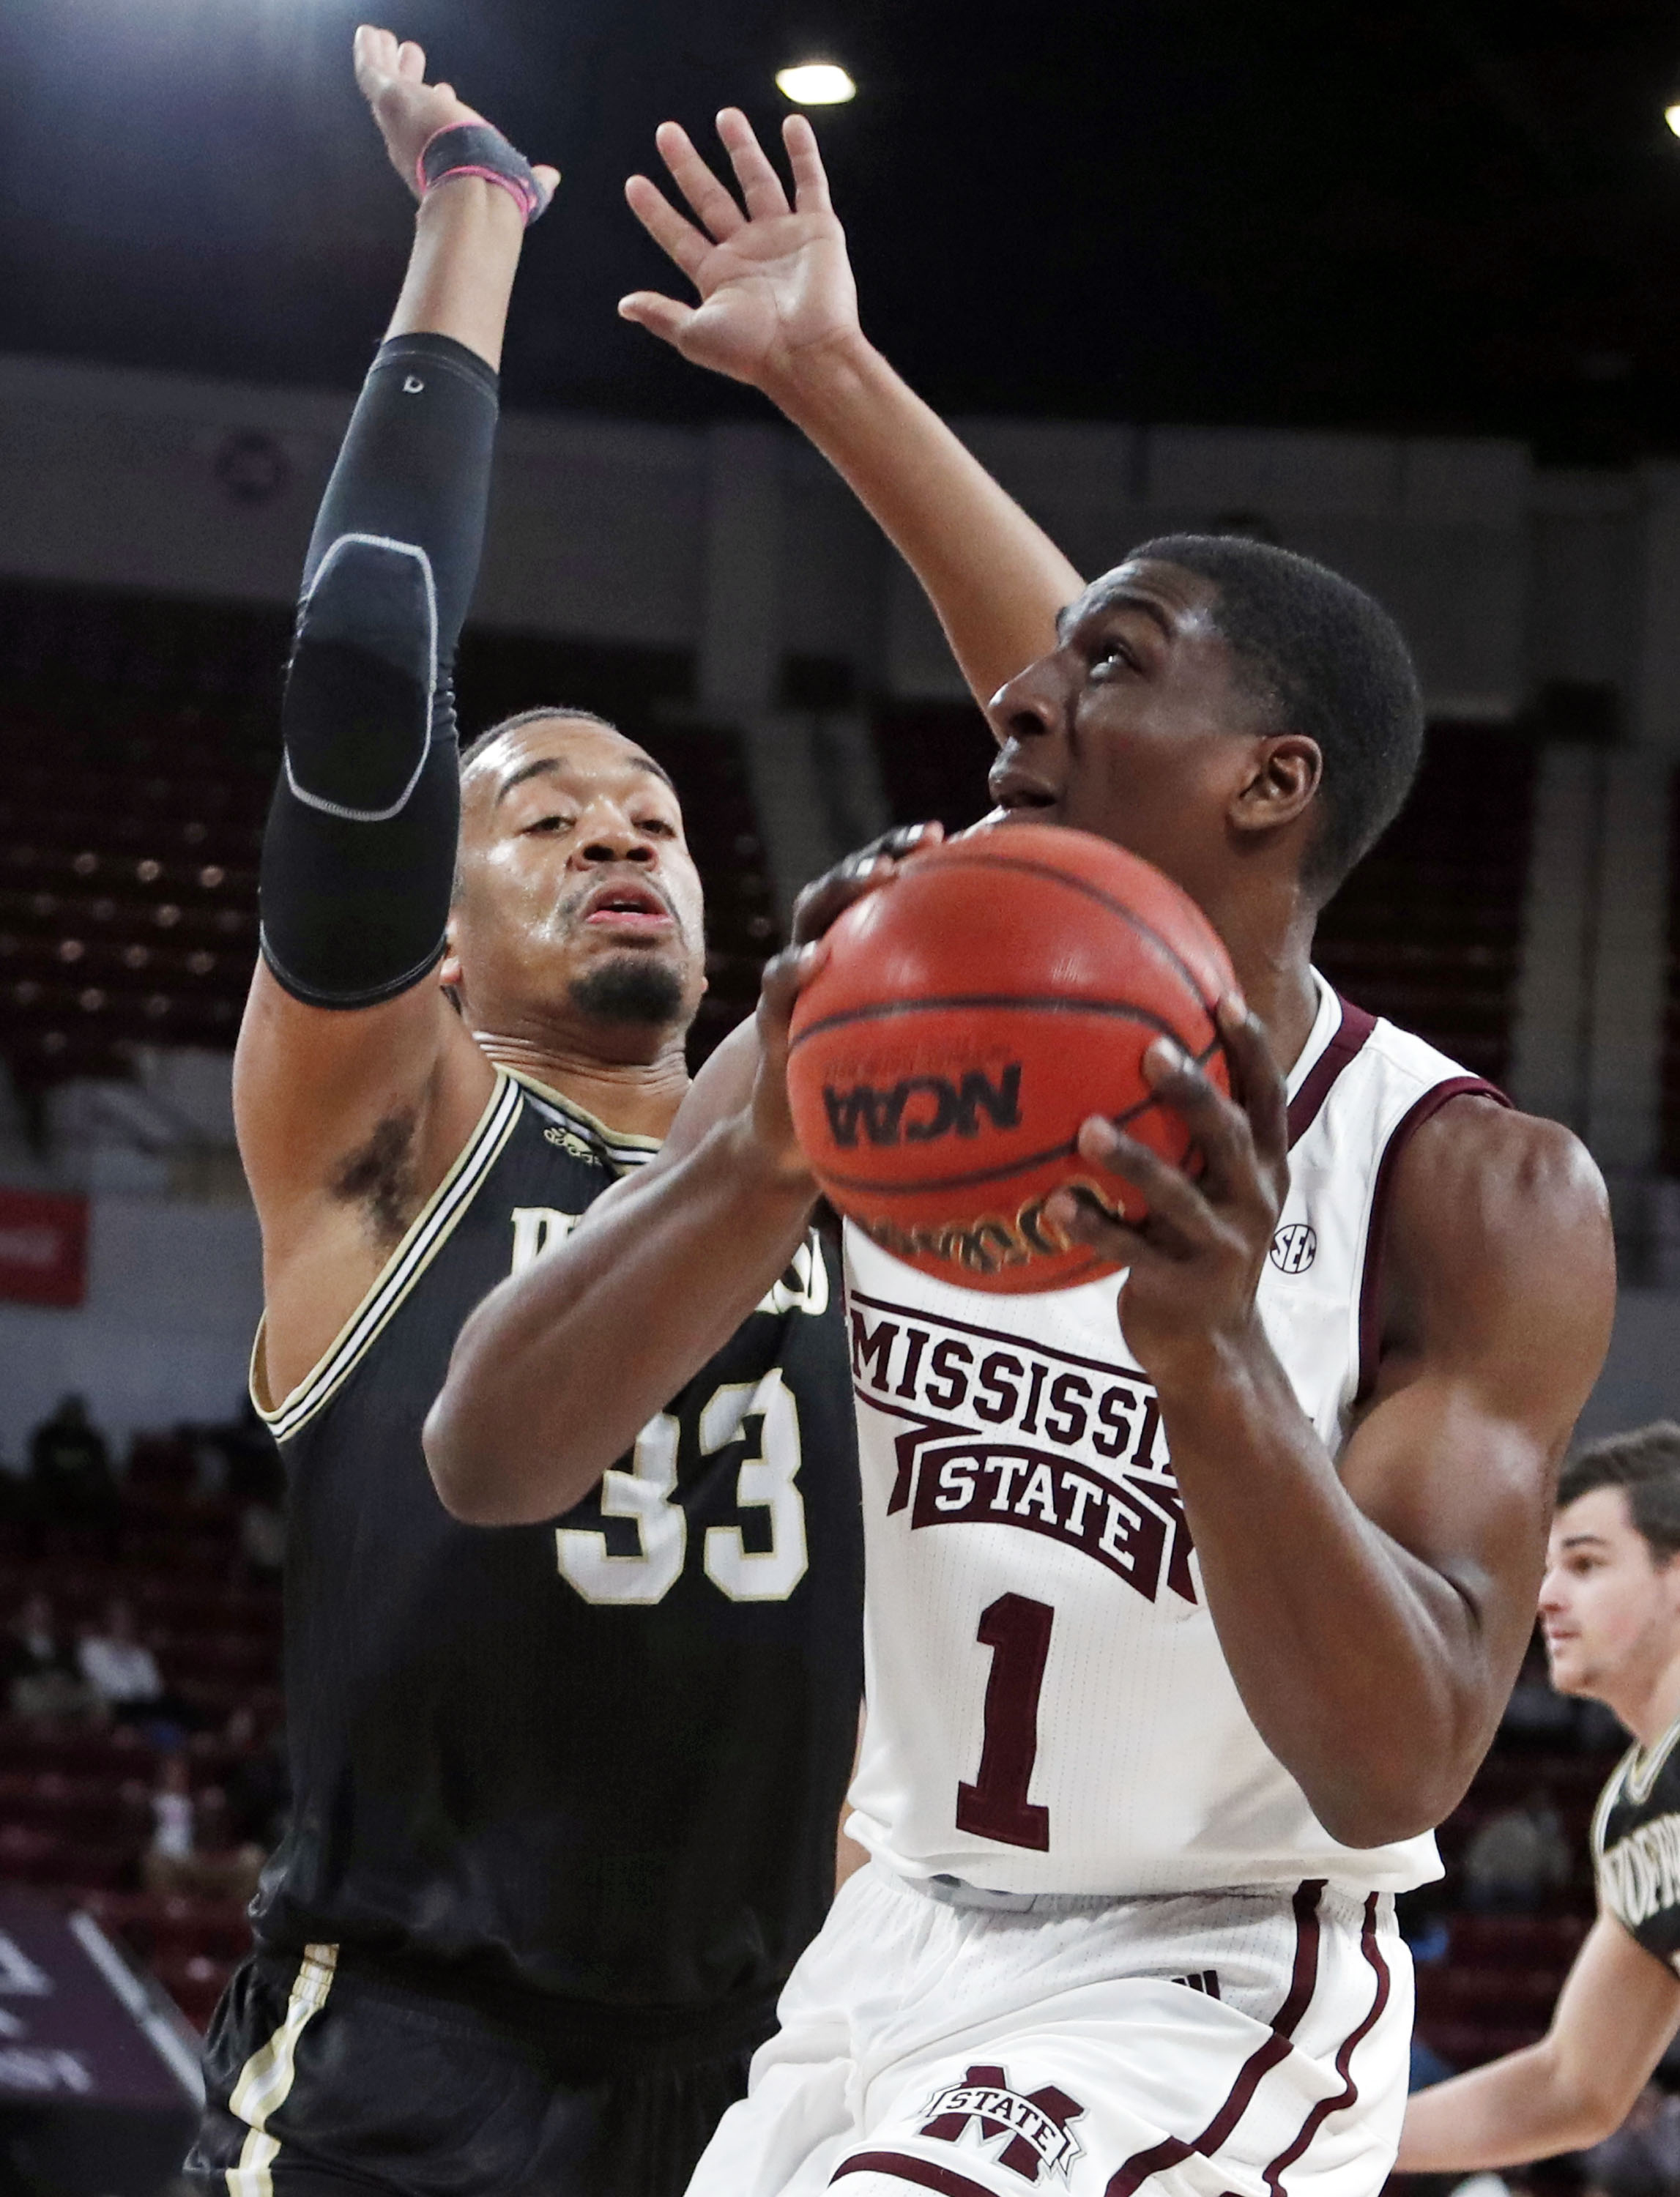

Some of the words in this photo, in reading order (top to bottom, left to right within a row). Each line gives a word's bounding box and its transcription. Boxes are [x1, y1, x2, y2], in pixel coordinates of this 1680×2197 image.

[822, 1060, 1023, 1148] NCAA
[1269, 1224, 1317, 1274] SEC
[850, 1307, 1175, 1475] MISSISSI
[555, 1367, 809, 1605] 33
[935, 1456, 1141, 1571] STATE
[956, 1592, 1054, 1852] 1
[946, 2092, 1055, 2151] STATE
